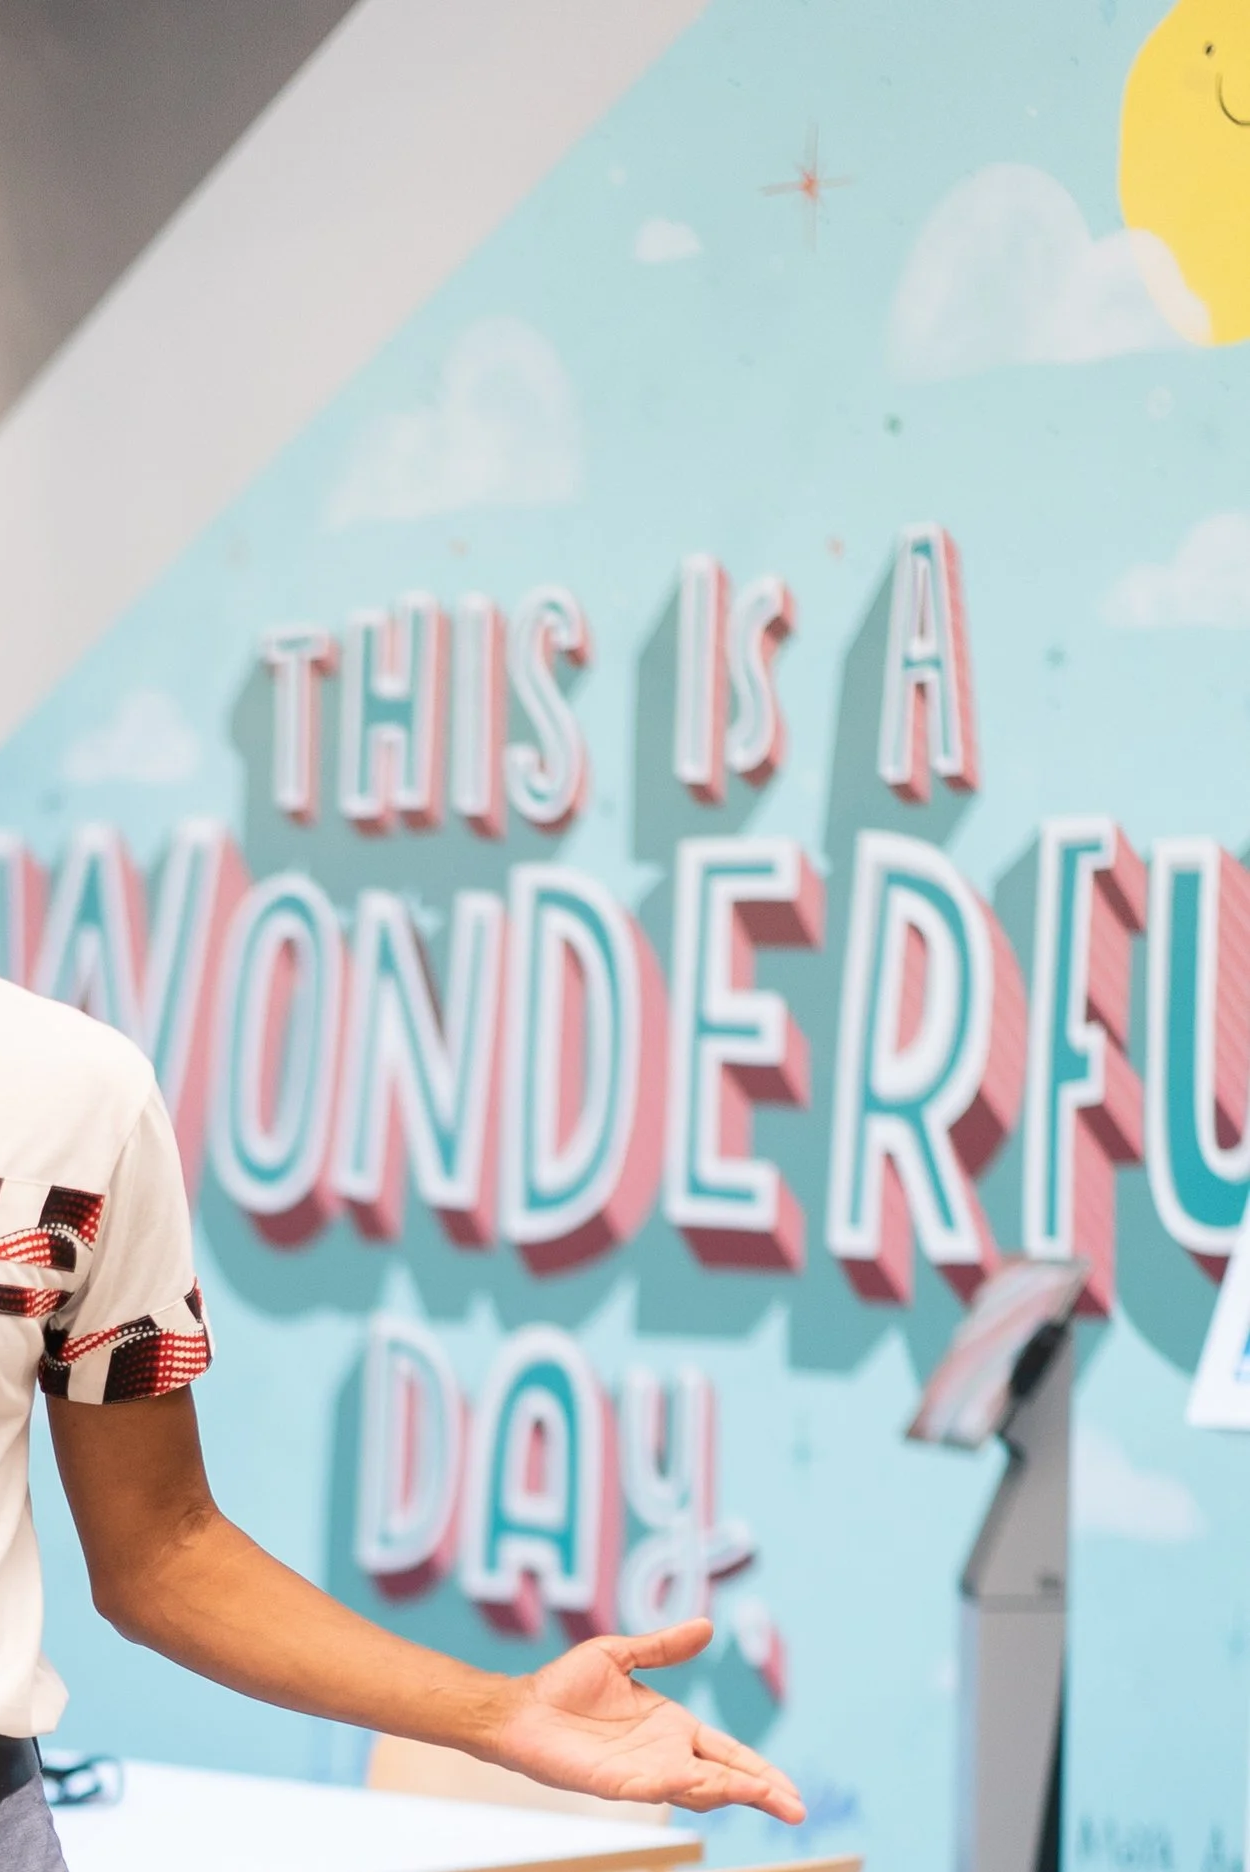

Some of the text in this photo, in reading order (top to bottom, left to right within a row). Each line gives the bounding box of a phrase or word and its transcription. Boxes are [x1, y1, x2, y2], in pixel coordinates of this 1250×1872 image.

[261, 521, 980, 836] THIS IS A
